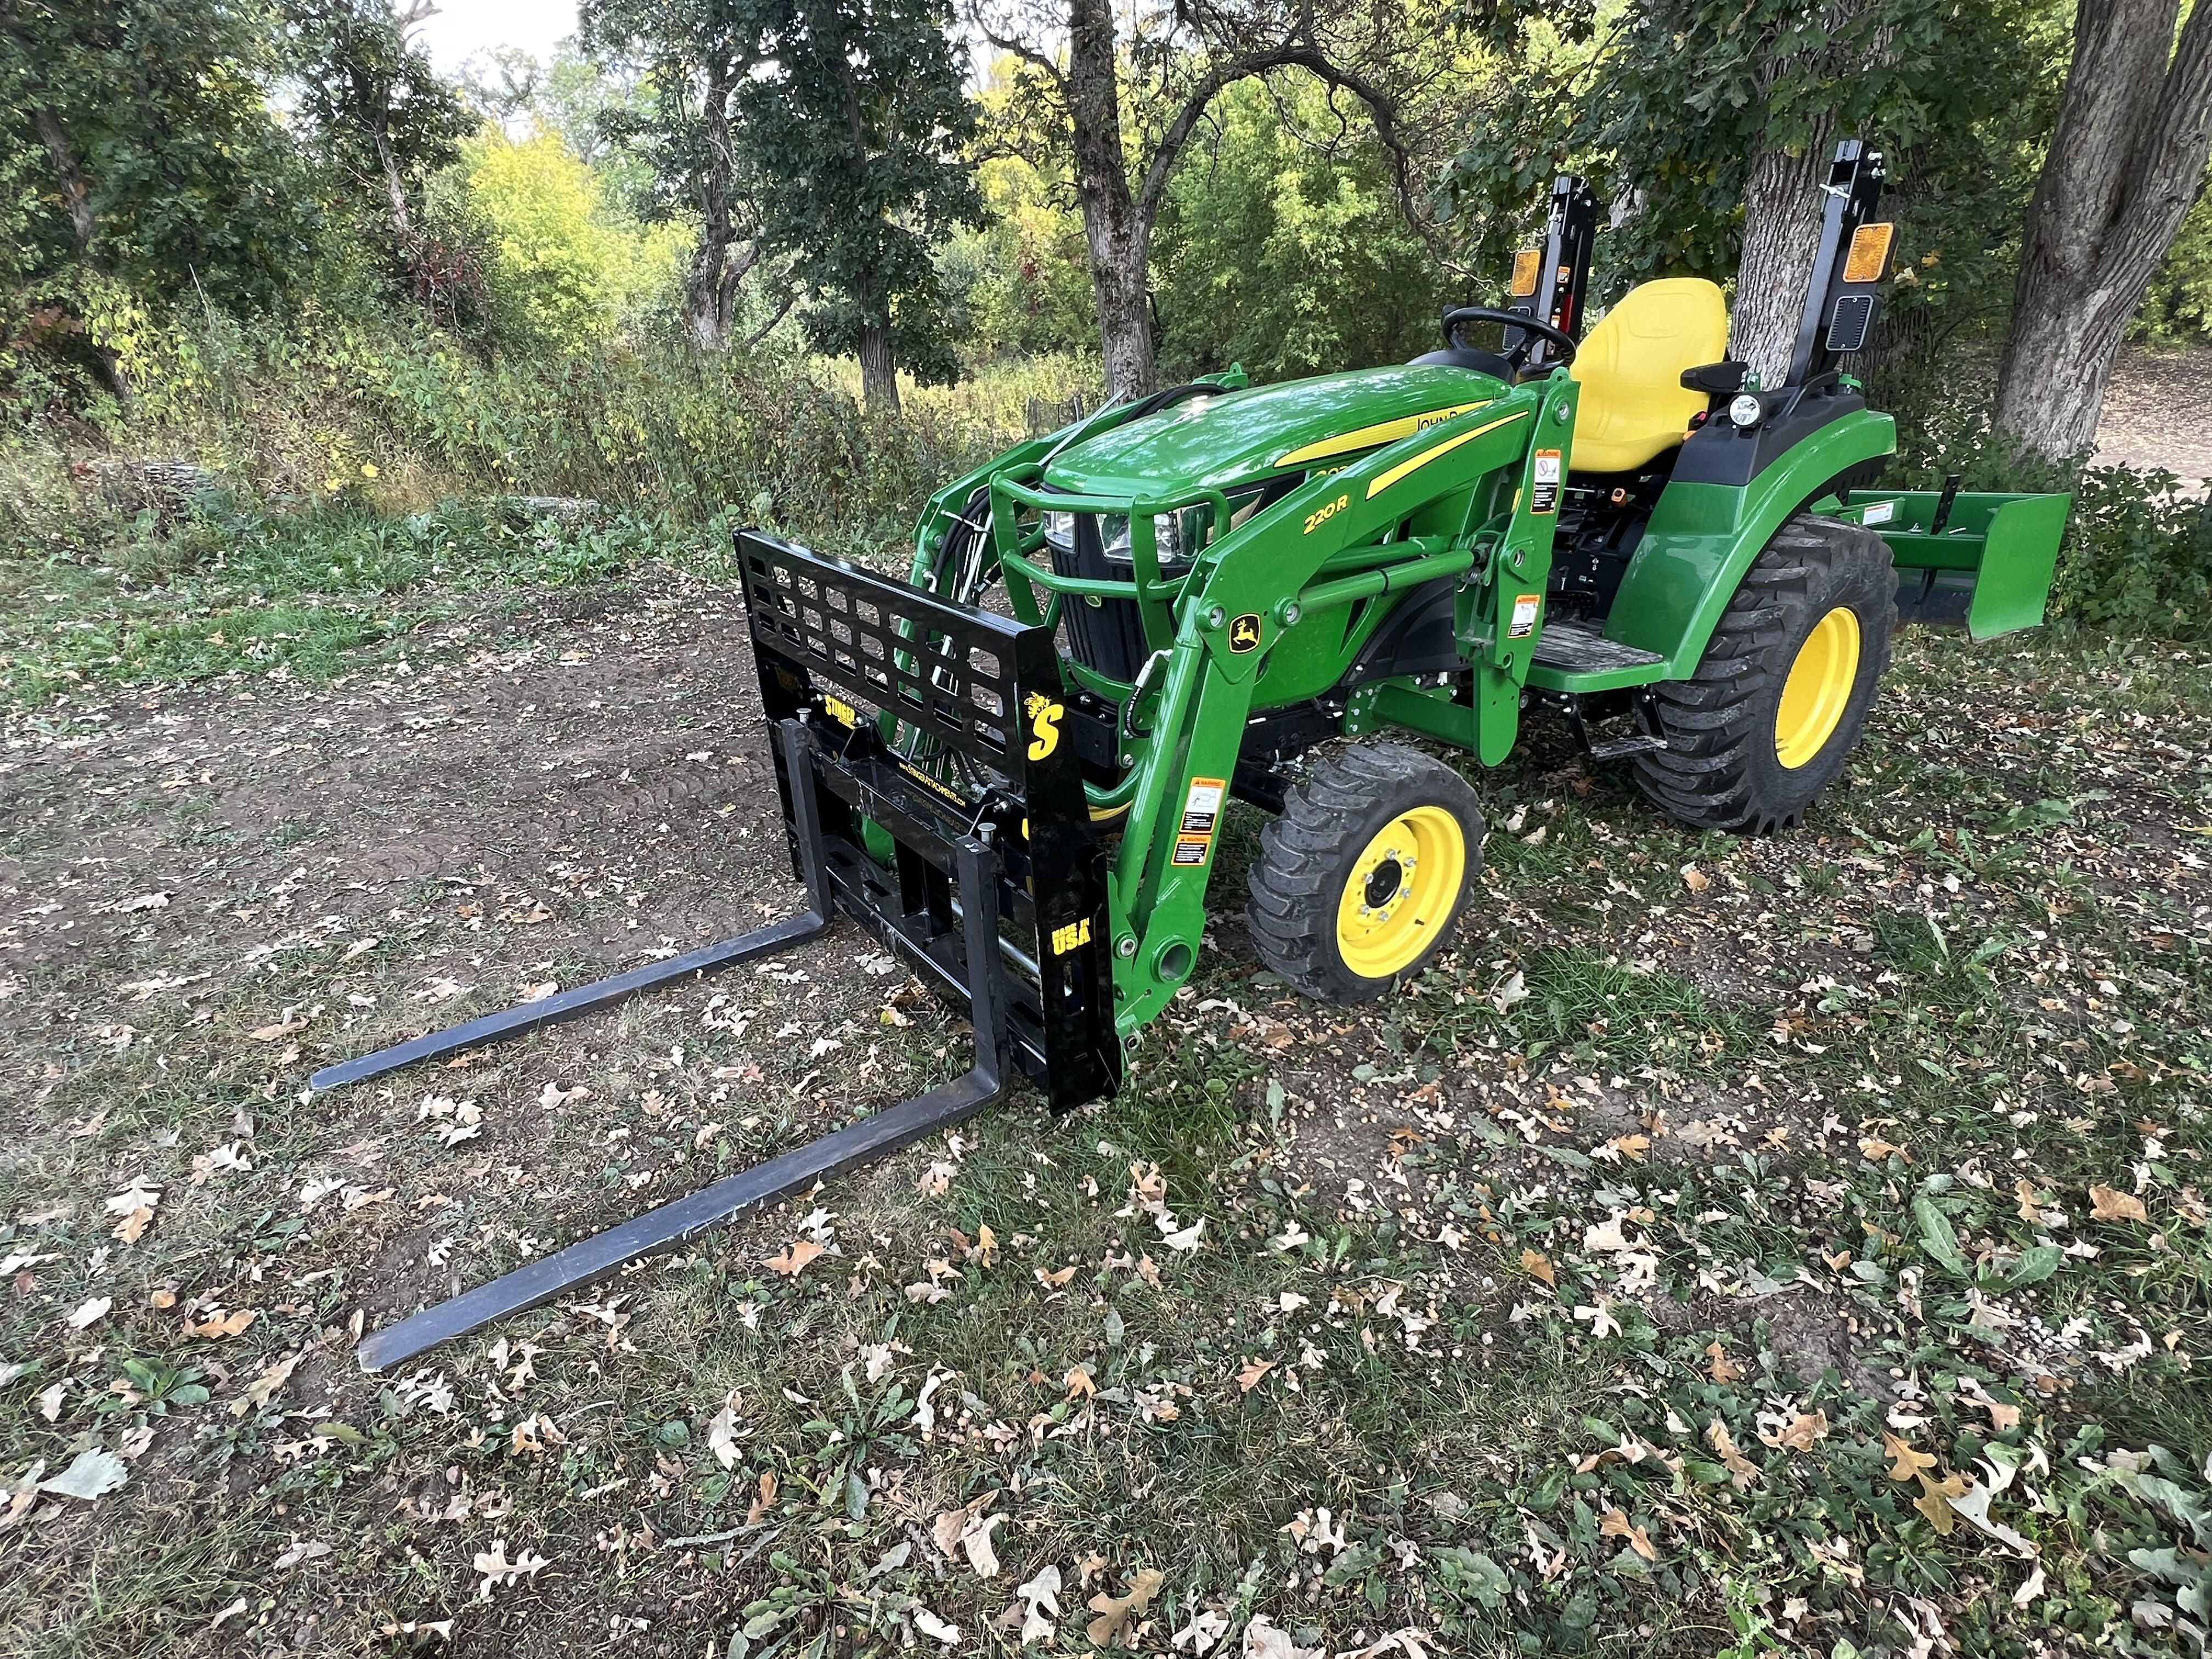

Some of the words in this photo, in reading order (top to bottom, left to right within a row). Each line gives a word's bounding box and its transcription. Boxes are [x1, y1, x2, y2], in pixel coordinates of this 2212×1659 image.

[825, 694, 855, 723] STINGER
[1027, 703, 1064, 761] S
[1052, 922, 1077, 940] MADE
[1080, 917, 1090, 928] IN
[1053, 926, 1091, 955] USA
